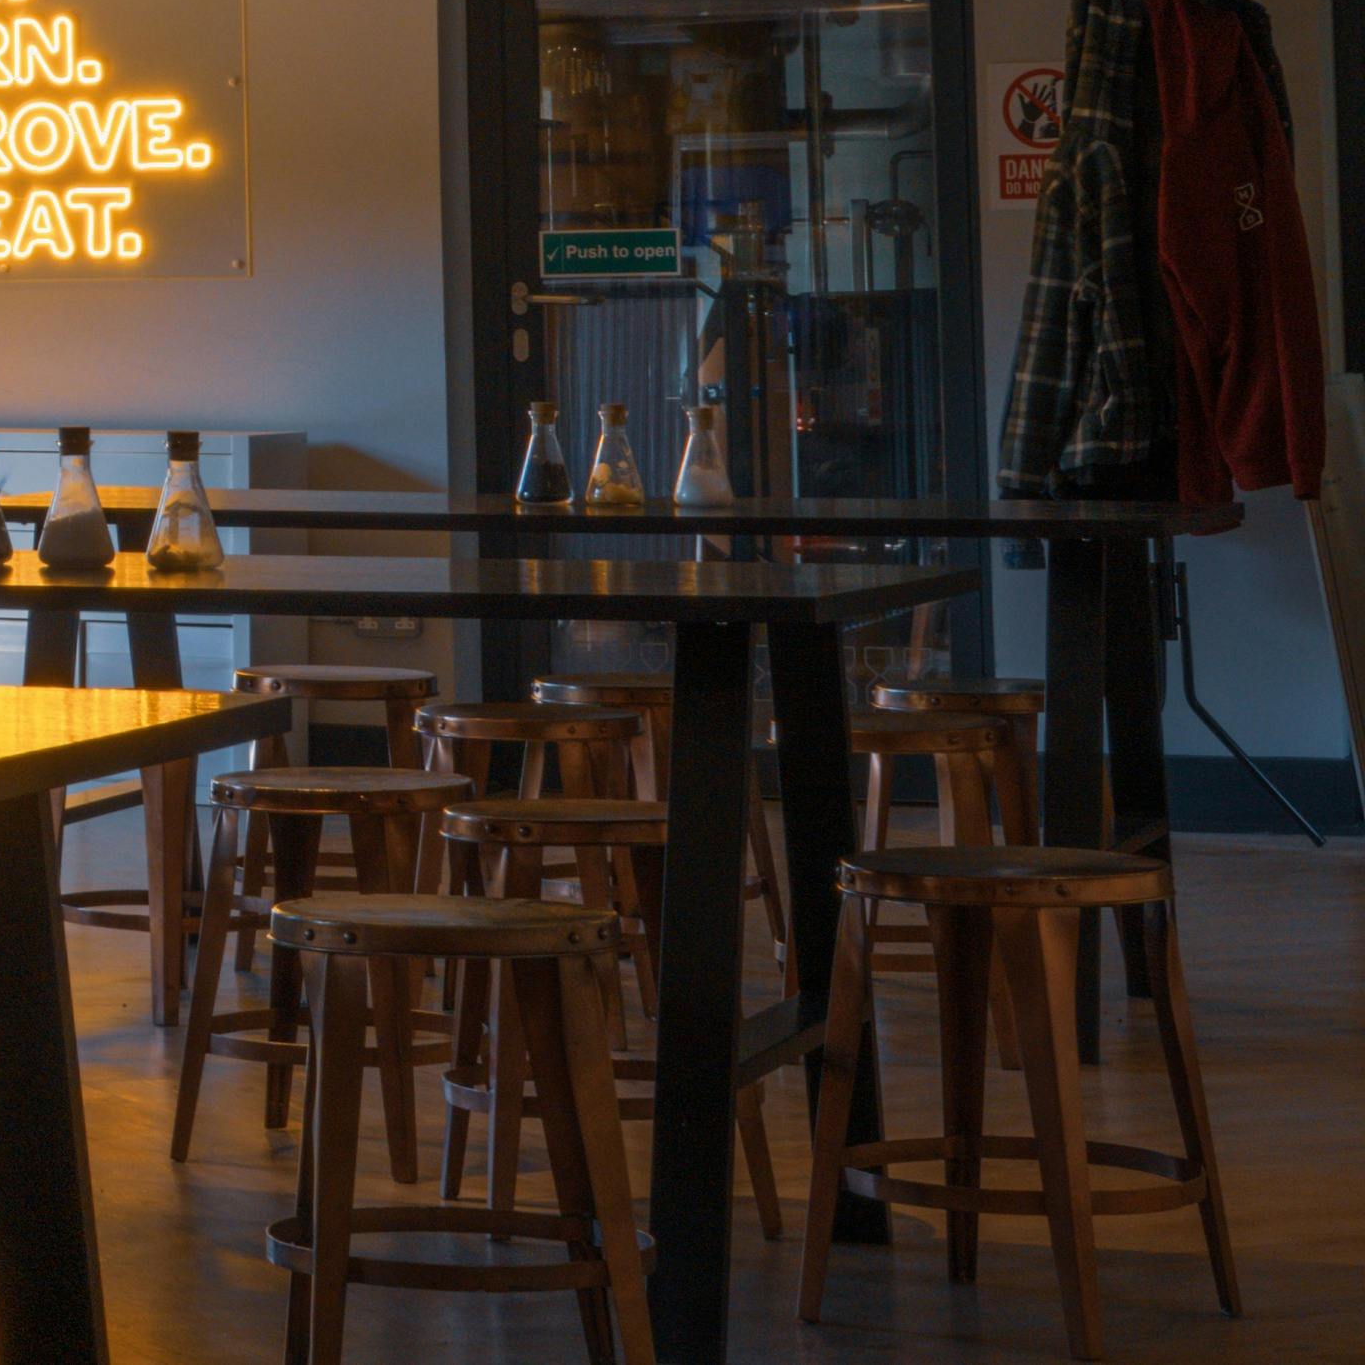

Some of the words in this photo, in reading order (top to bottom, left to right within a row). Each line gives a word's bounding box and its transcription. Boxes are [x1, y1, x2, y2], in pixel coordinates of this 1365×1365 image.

[1005, 158, 1049, 180] DAN
[1006, 182, 1021, 195] DO
[1024, 181, 1041, 195] NO
[565, 245, 608, 259] Push
[613, 246, 629, 258] to
[634, 245, 675, 260] open
